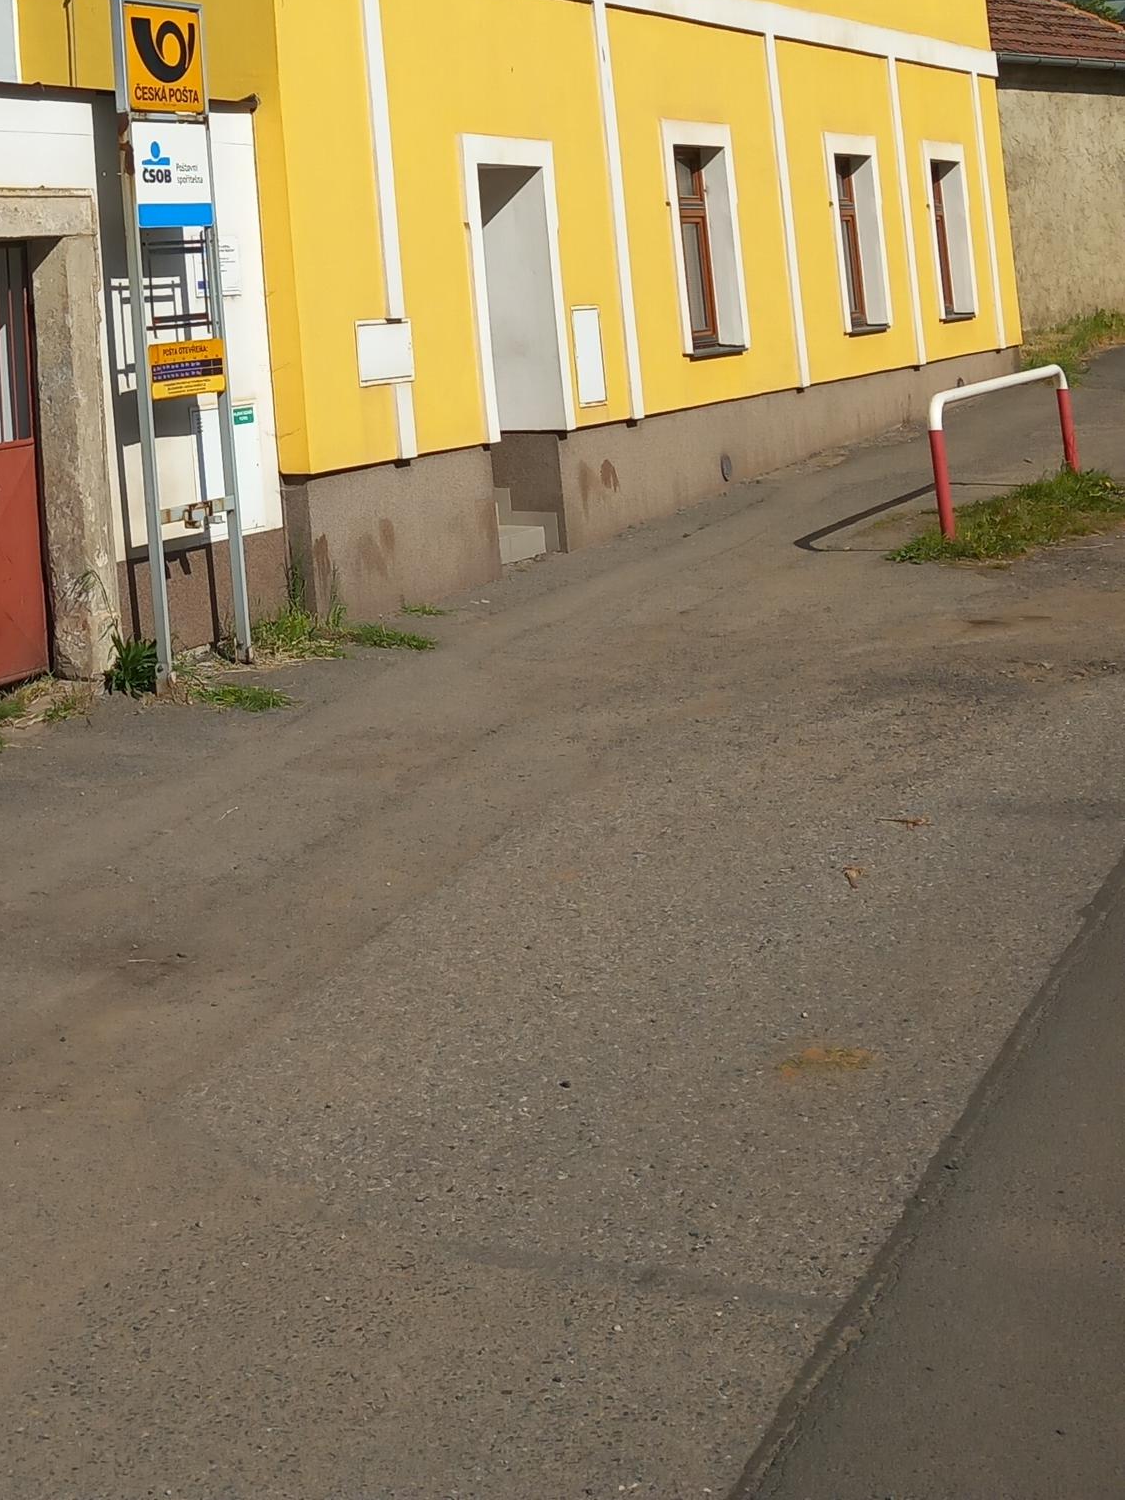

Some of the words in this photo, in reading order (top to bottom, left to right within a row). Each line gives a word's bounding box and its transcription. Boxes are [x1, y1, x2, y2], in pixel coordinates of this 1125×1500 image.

[135, 84, 168, 102] ČESKÁ
[169, 86, 200, 104] POŠTA
[176, 163, 198, 172] Poštovní
[142, 167, 172, 184] ČSOB
[163, 346, 177, 356] POŠTA
